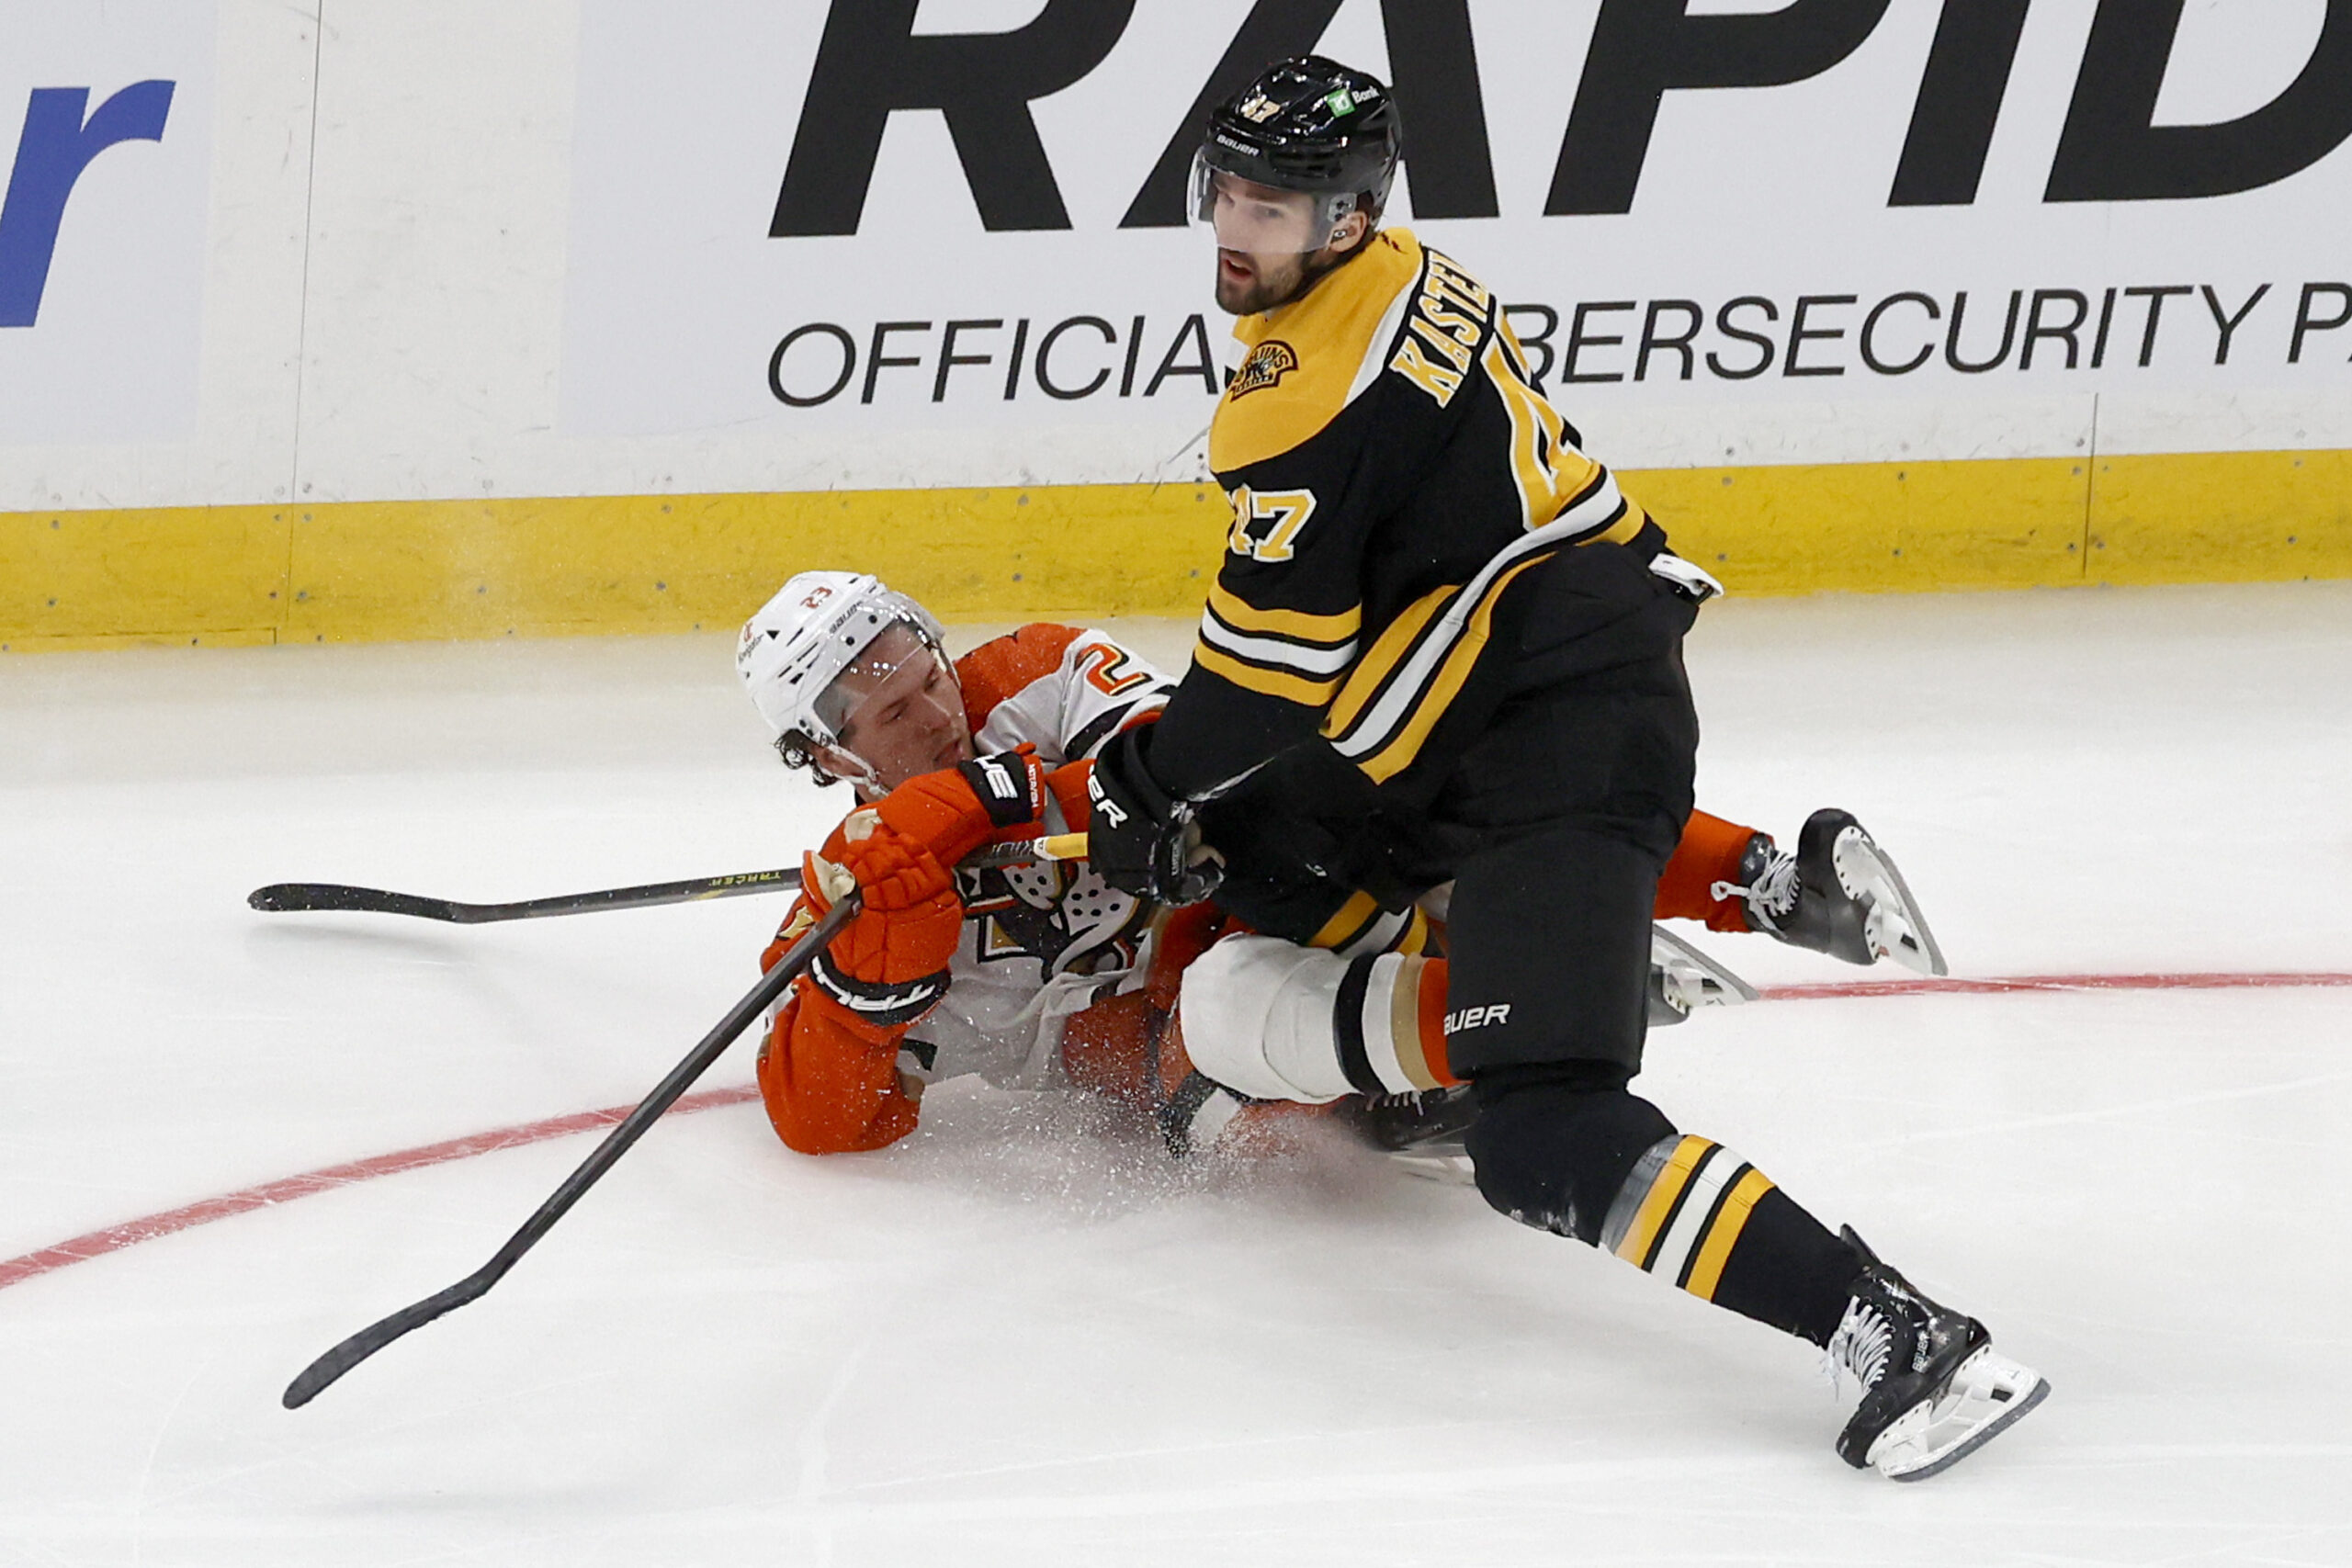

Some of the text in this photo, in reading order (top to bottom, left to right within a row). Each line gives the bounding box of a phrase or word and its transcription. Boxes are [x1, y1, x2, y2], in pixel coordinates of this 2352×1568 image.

[1351, 85, 1380, 105] Bank
[768, 313, 1237, 407] OFFICIA
[1503, 283, 2273, 386] BERSECURITY
[799, 585, 832, 610] 23
[1073, 642, 1154, 696] 2
[973, 754, 1019, 800] UE
[1442, 1003, 1511, 1036] AUER
